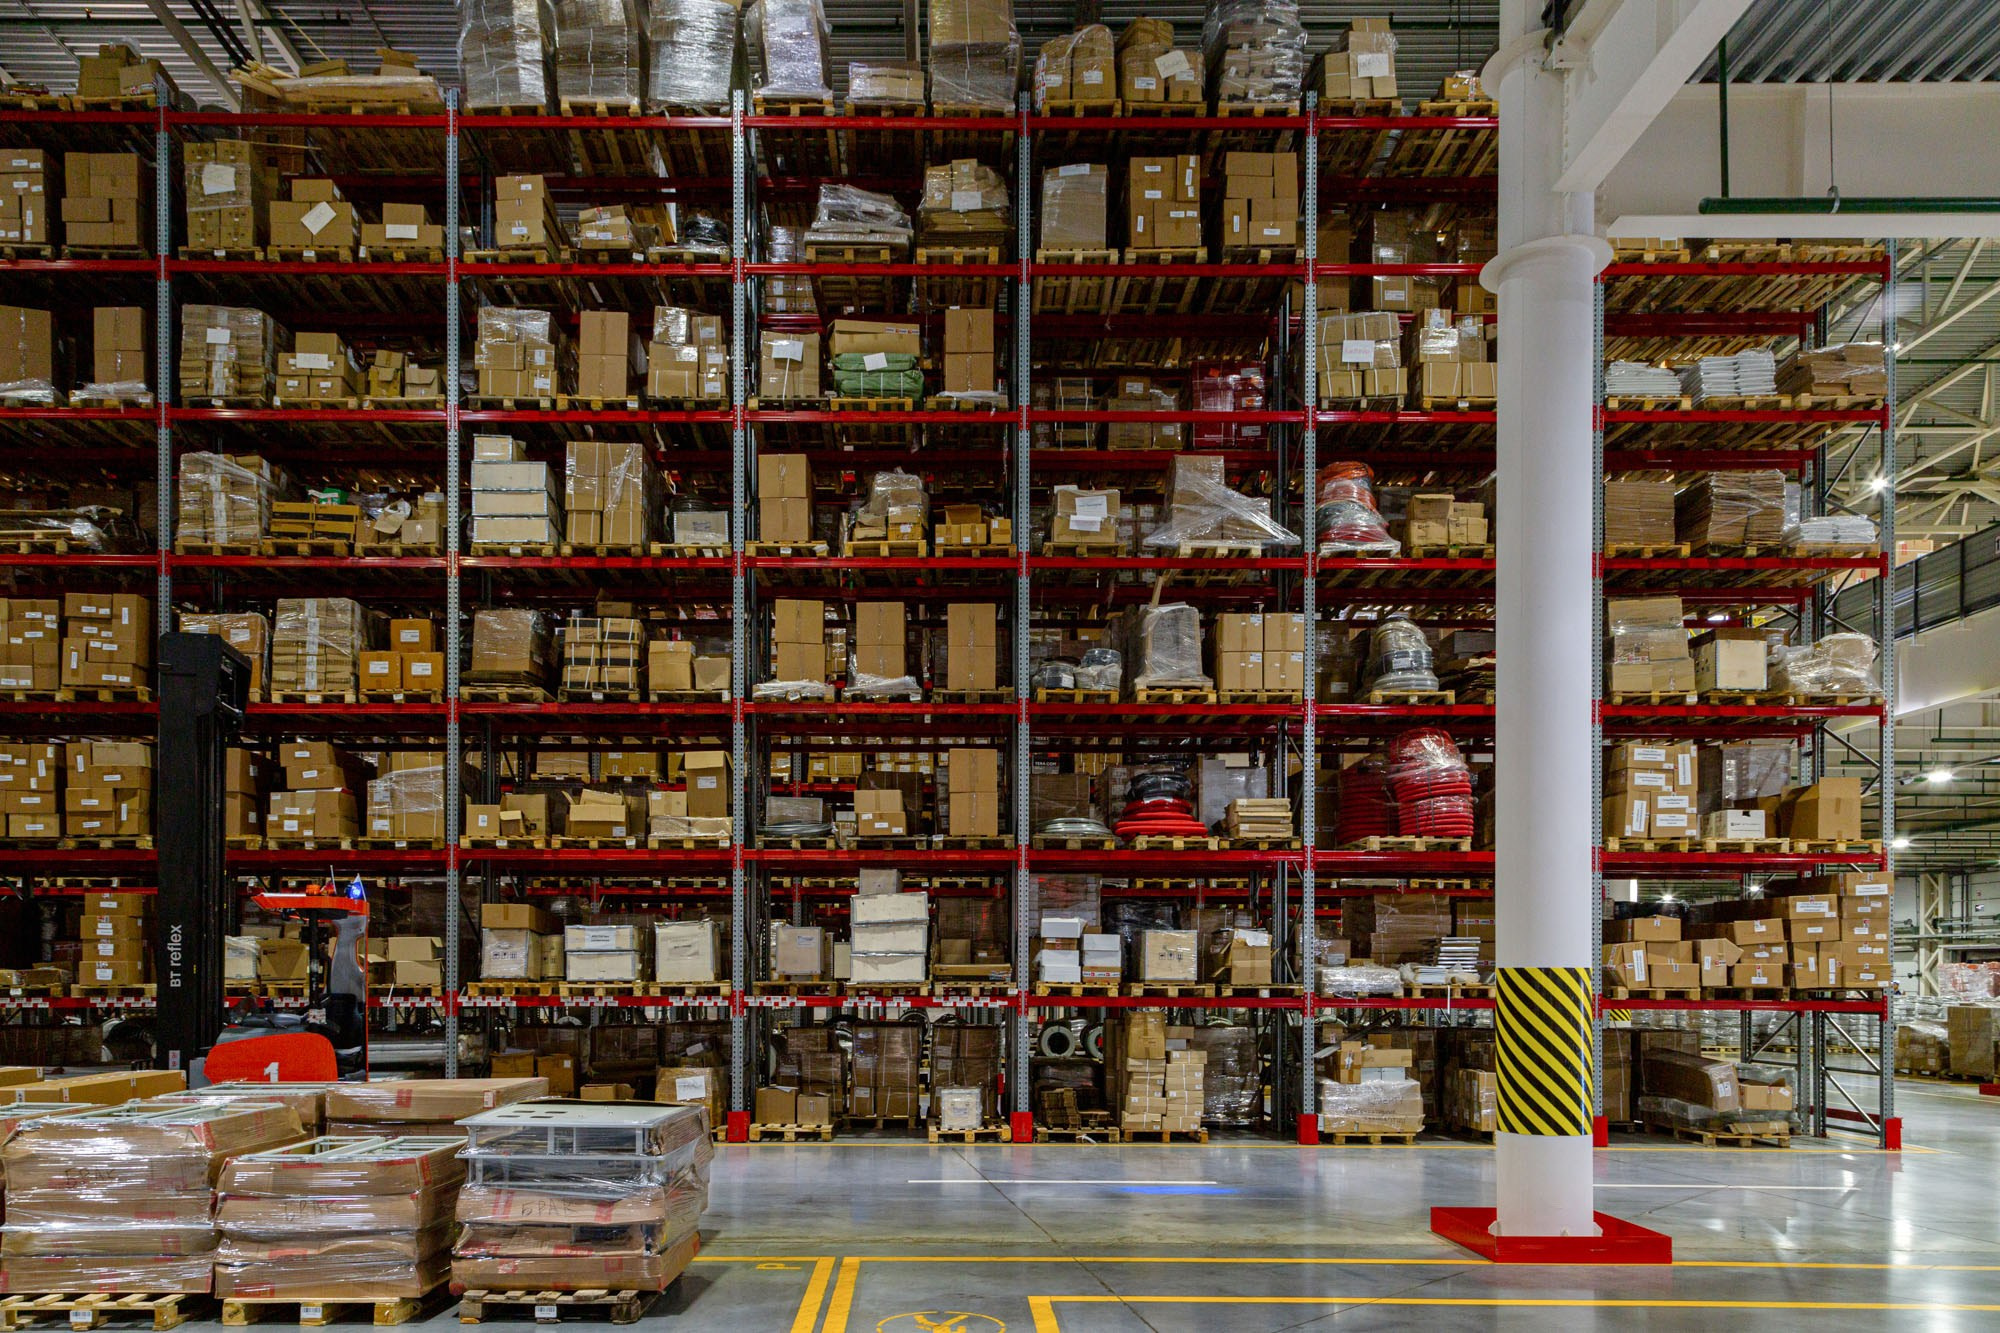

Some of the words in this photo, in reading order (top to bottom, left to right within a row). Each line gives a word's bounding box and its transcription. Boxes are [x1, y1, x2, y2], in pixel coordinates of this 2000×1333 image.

[167, 924, 182, 967] reflex
[170, 971, 182, 988] BT
[263, 1061, 280, 1083] 1
